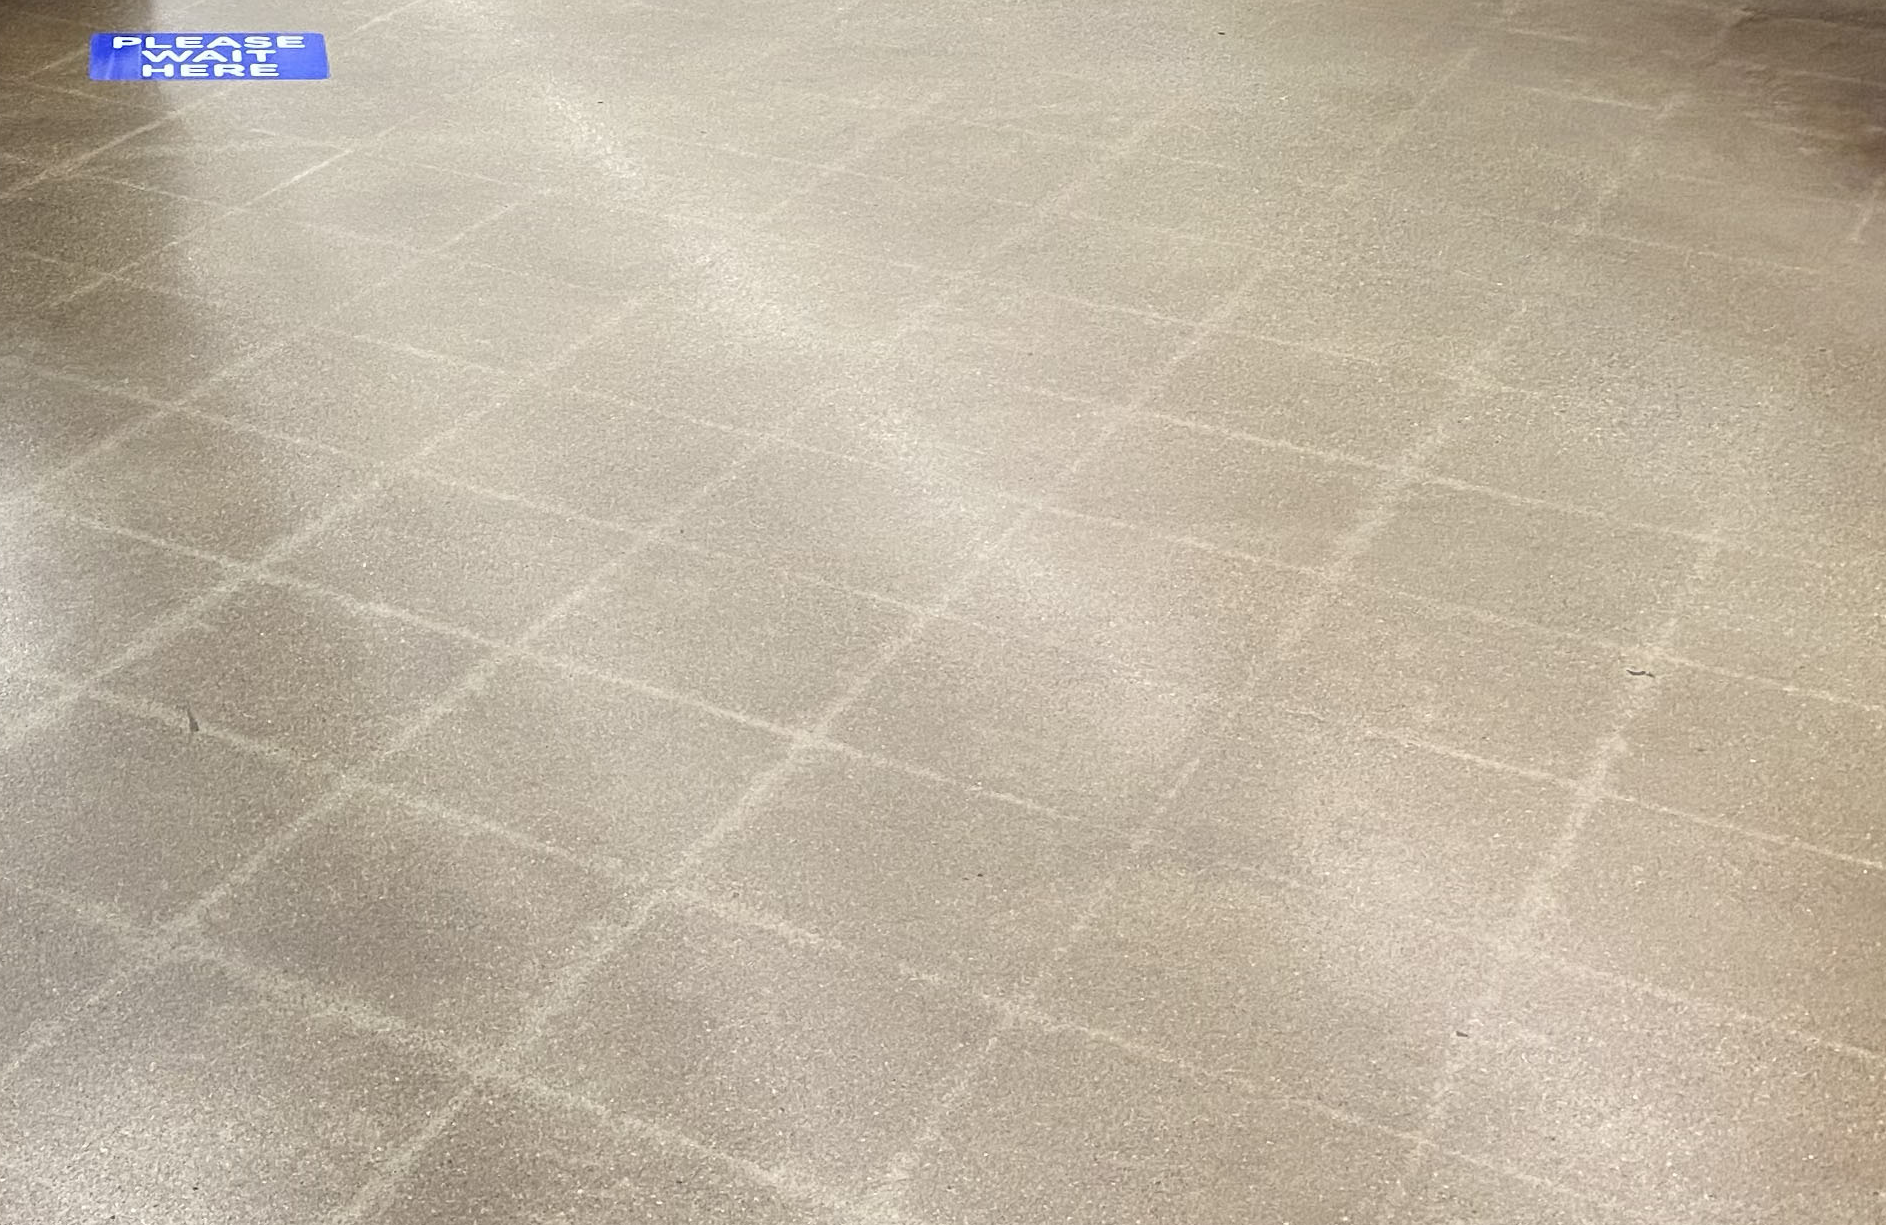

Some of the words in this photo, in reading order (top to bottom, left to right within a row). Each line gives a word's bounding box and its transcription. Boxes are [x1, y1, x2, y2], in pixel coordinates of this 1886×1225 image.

[112, 35, 306, 49] PLEASE
[141, 49, 277, 63] WAIT
[141, 63, 280, 77] HERE
